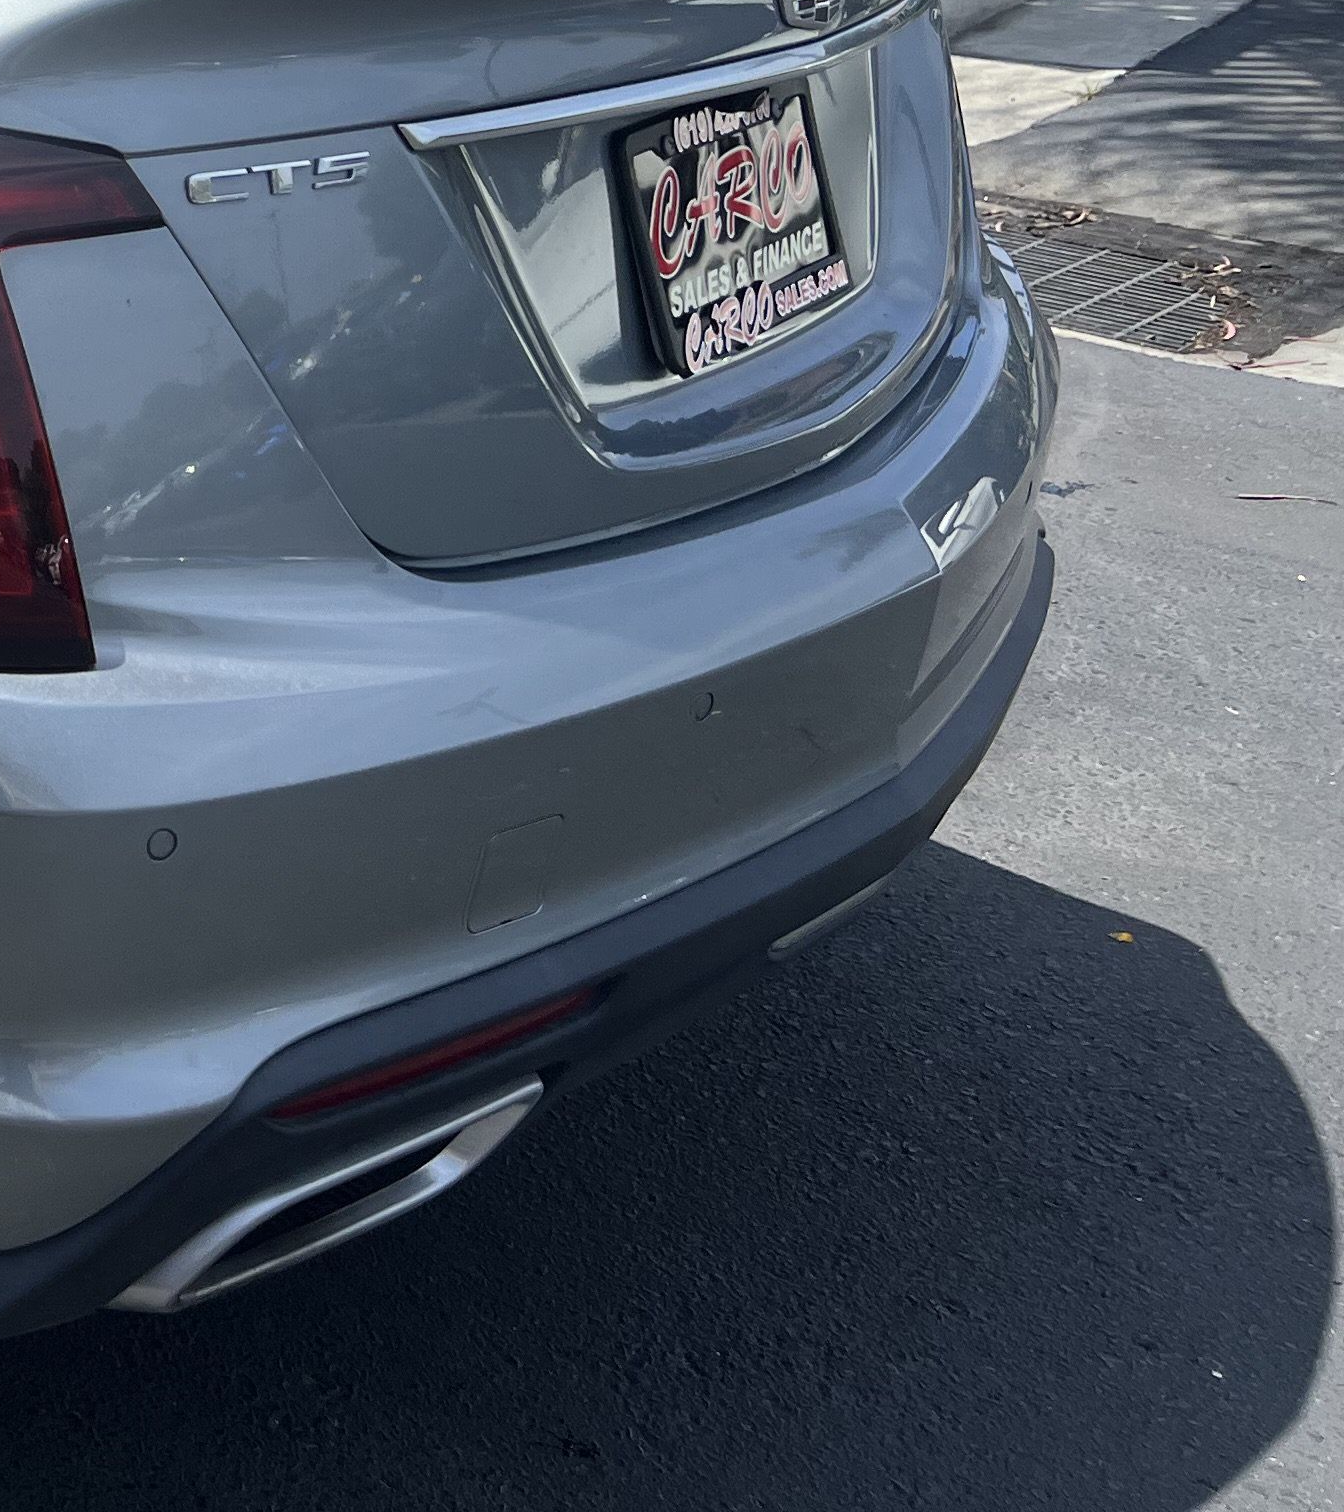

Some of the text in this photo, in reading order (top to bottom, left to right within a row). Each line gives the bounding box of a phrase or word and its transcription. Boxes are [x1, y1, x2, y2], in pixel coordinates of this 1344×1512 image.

[673, 106, 714, 154] (619)
[650, 120, 813, 279] CARCO
[669, 220, 824, 318] SALES & FINANCE
[685, 259, 849, 374] CARCO SALES.COM
